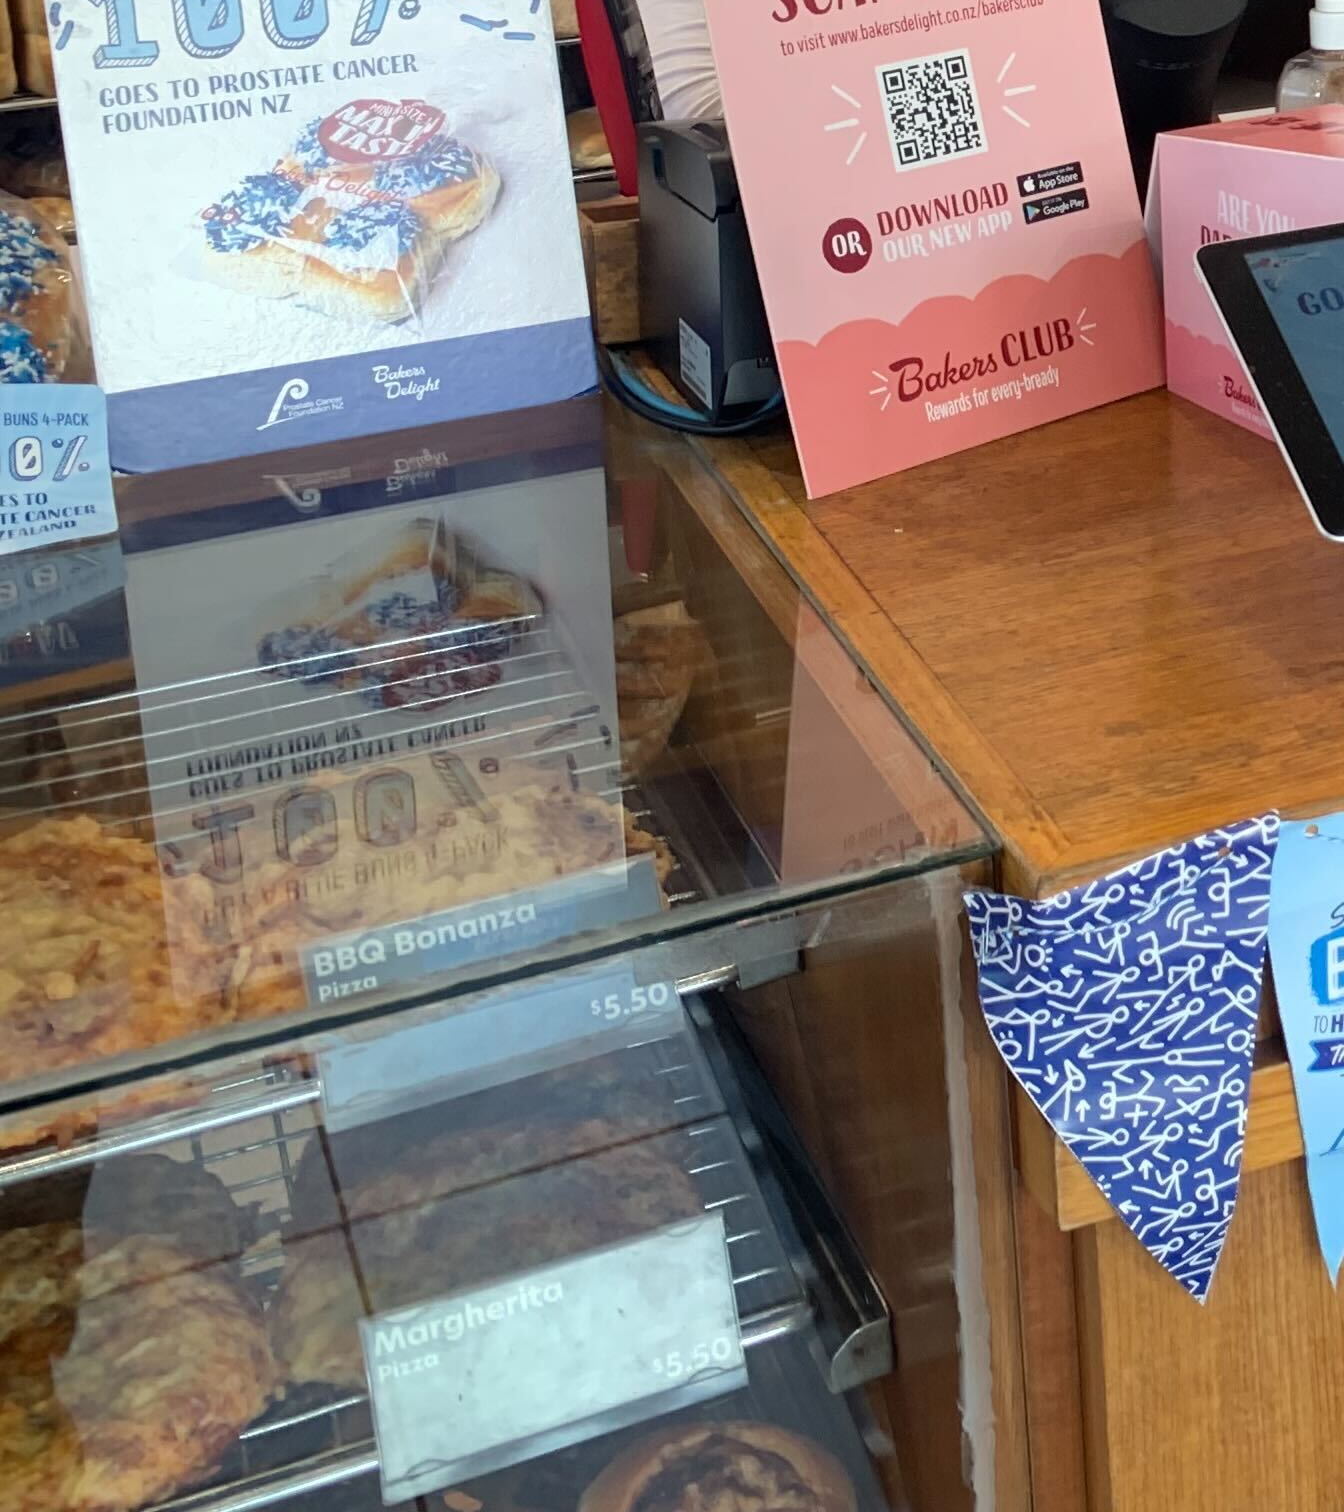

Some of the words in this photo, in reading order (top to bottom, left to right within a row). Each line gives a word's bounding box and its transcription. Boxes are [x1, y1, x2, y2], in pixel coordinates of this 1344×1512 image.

[780, 39, 794, 56] to
[796, 32, 826, 53] visit
[100, 82, 159, 108] GOES
[168, 78, 200, 100] TO
[209, 64, 324, 96] PROSTATE
[332, 53, 419, 81] CANCER
[103, 98, 254, 134] FOUNDATION
[261, 94, 292, 115] NZ
[1056, 170, 1078, 186] Store
[876, 182, 1009, 236] DOWNLOAD
[1218, 190, 1252, 235] ARE
[832, 230, 868, 258] OR
[882, 234, 930, 263] OUR
[928, 220, 972, 252] NEW
[977, 210, 1014, 237] APP
[372, 364, 426, 384] Bakers
[888, 352, 998, 402] Bakers
[1000, 318, 1074, 368] CLUB
[385, 376, 440, 402] Delight
[925, 390, 972, 423] Rewards
[972, 388, 989, 407] for
[992, 365, 1060, 403] every-bready
[3, 412, 38, 427] BUNS
[42, 412, 89, 428] 4-PACK
[23, 492, 48, 506] TO
[28, 504, 96, 521] CANCER
[312, 938, 388, 978] BBQ
[395, 900, 537, 958] Bonanza
[320, 974, 378, 1003] Pizza
[589, 981, 669, 1022] $5.50
[1314, 1014, 1328, 1033] TO
[374, 1278, 564, 1356] Margherita
[377, 1350, 440, 1382] Pizza
[652, 1336, 732, 1379] $5.50
